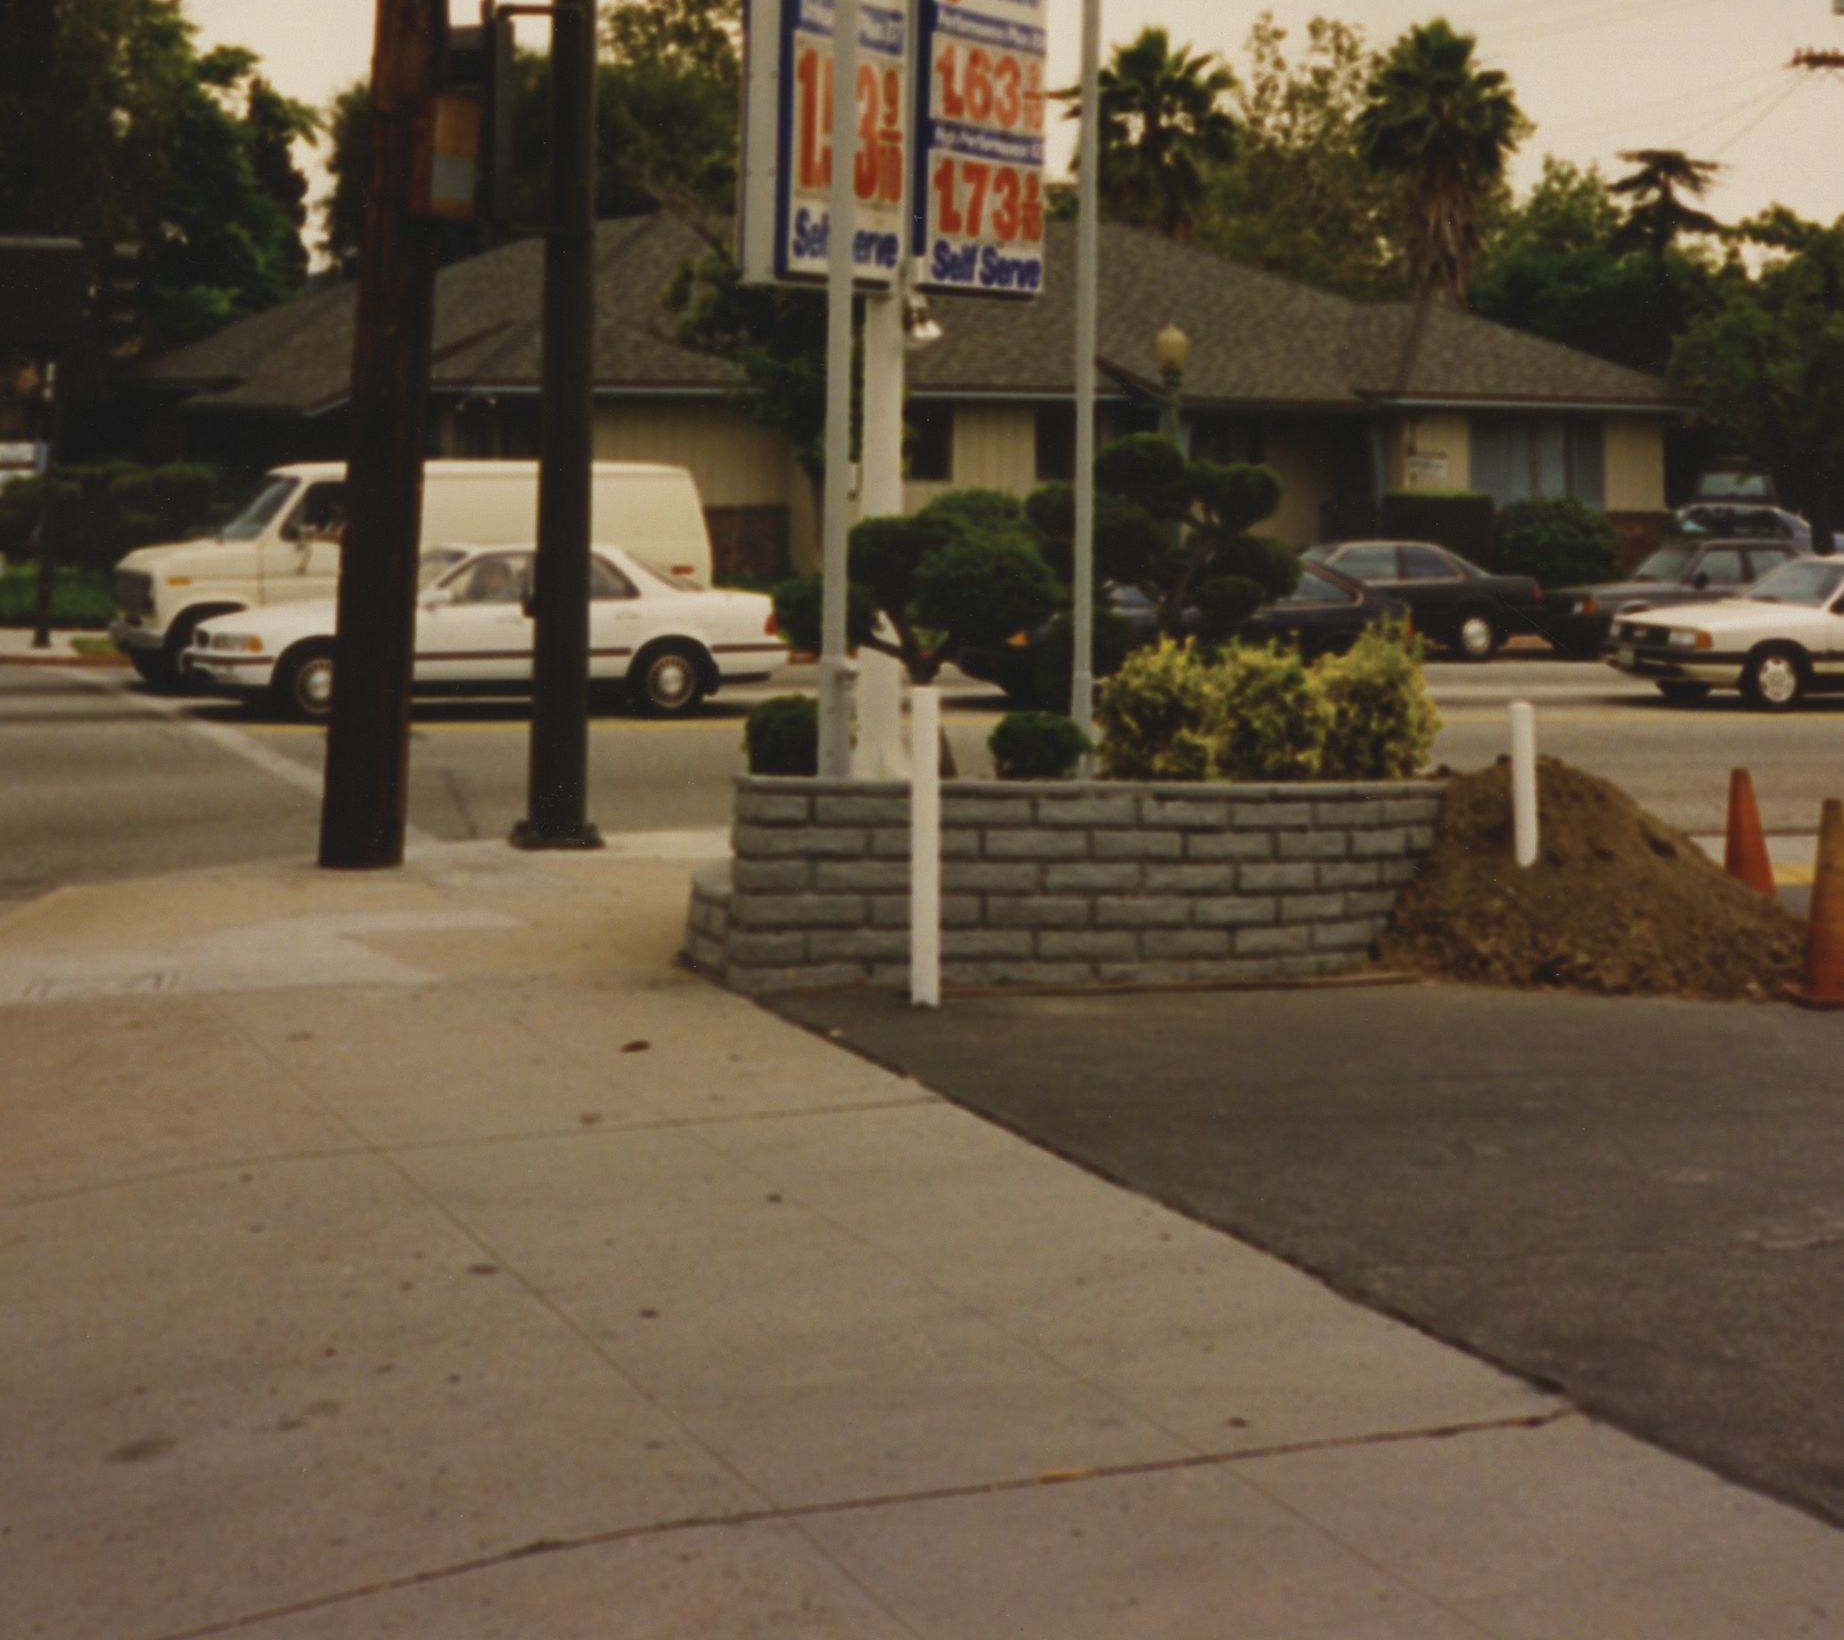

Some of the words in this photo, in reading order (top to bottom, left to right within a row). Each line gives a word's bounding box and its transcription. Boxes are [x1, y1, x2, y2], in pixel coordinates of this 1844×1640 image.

[853, 229, 899, 268] erve
[931, 238, 978, 283] Self
[980, 245, 1041, 290] Serve
